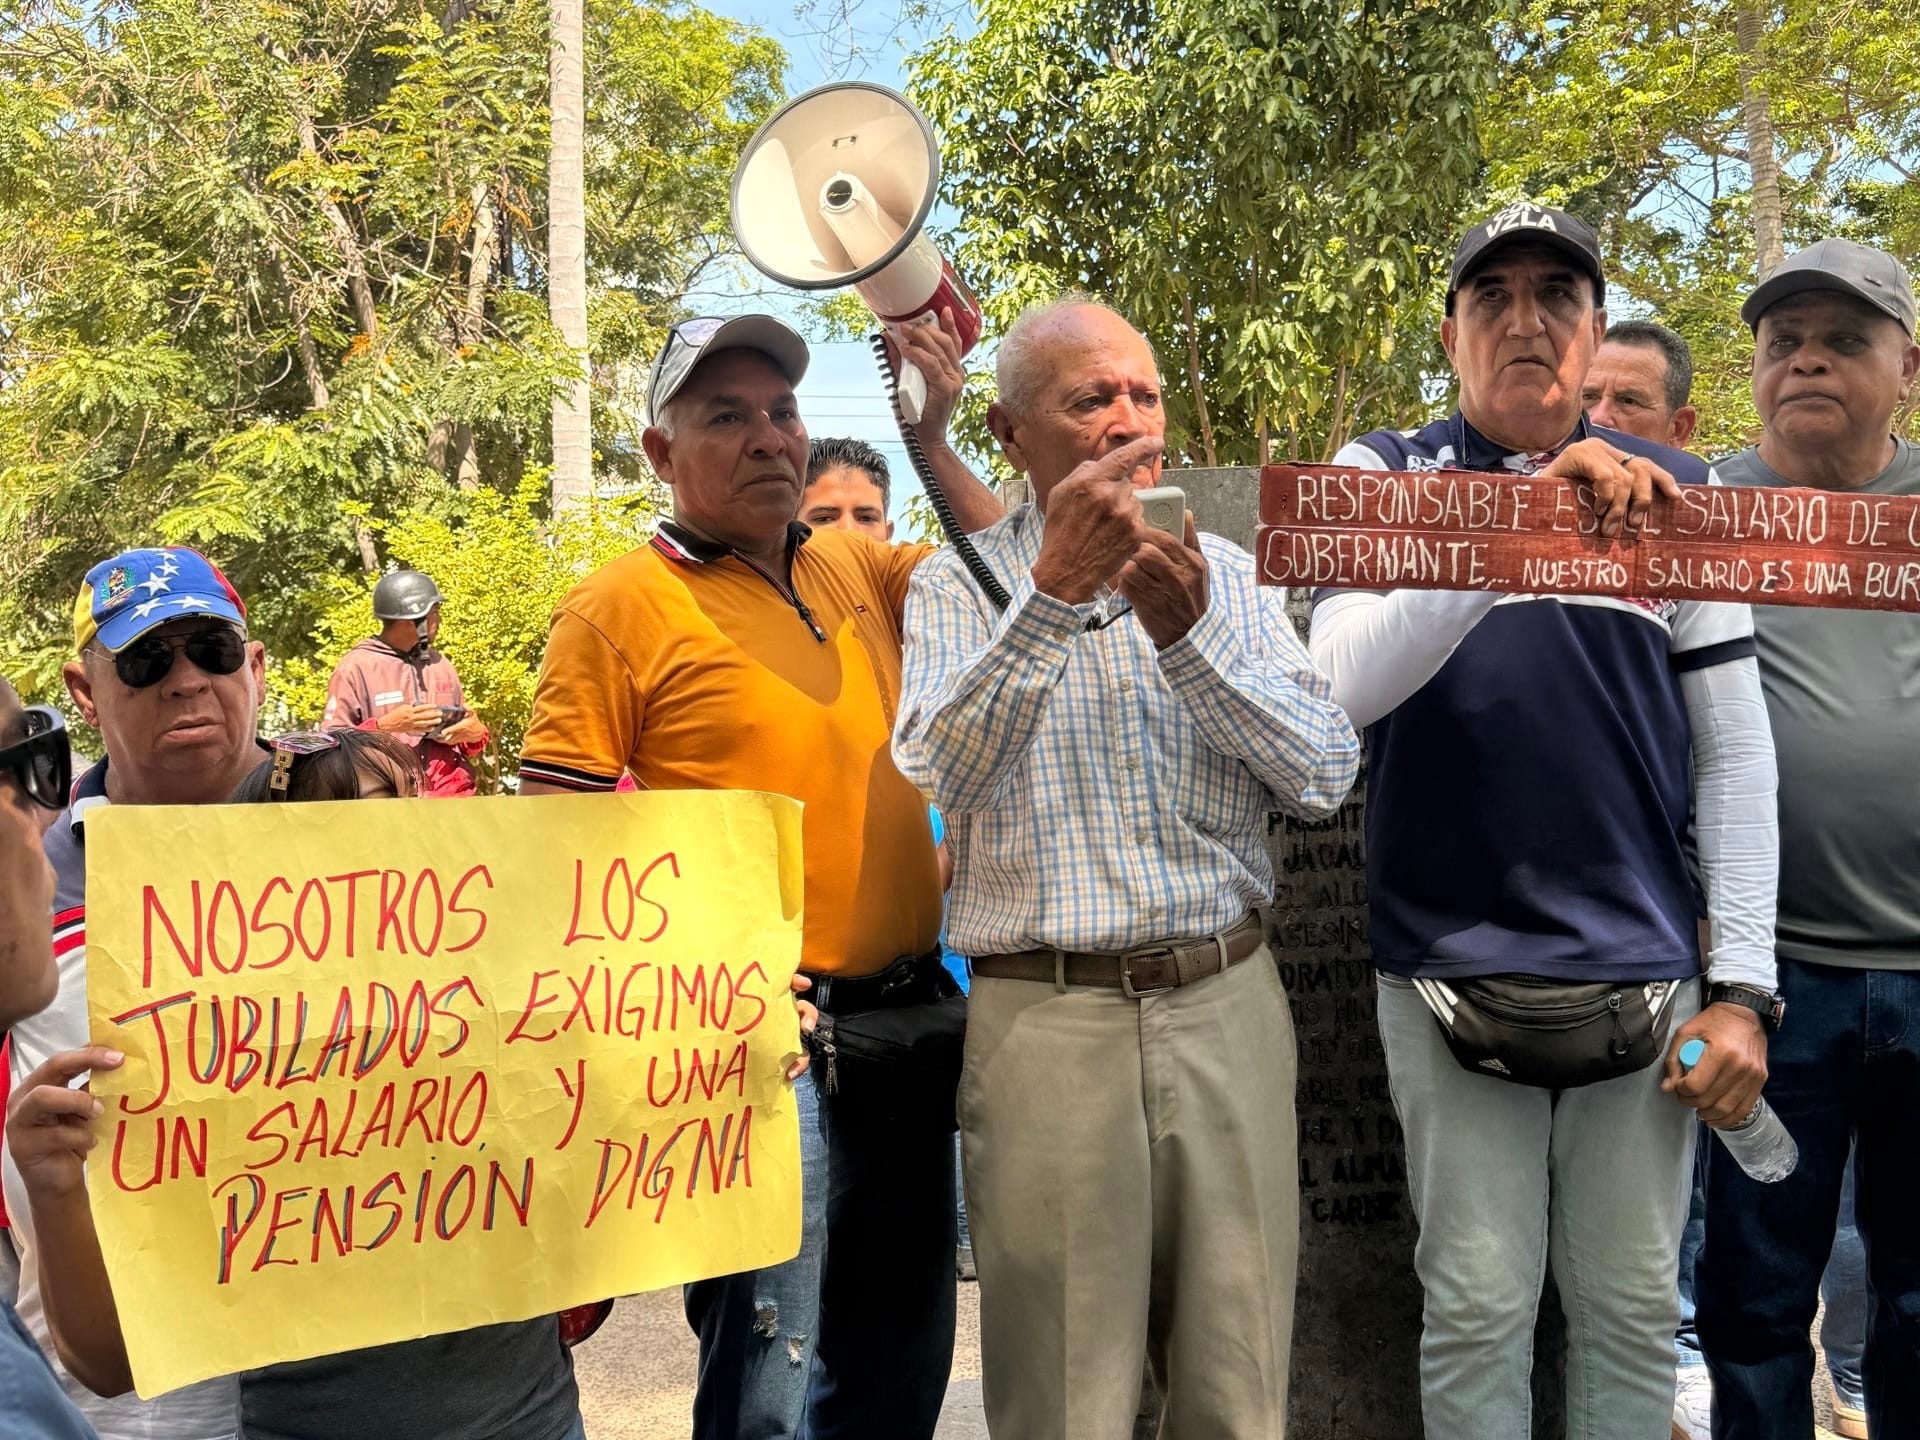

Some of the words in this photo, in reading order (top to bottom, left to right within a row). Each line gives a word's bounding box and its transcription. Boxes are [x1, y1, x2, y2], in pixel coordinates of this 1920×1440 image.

[1485, 210, 1558, 238] VZLA
[1296, 474, 1532, 532] RESPONSABLE
[1552, 484, 1599, 534] ES
[1676, 487, 1827, 545] SALARIO
[1846, 500, 1890, 546] DE
[1522, 558, 1628, 589] NUESTRO
[1646, 557, 1751, 591] SALARIO
[1760, 560, 1794, 593] ES
[1804, 561, 1853, 595] UNA
[1864, 562, 1920, 602] BUR
[142, 863, 495, 988] NOSOTROS
[563, 851, 681, 947] LOS
[110, 973, 485, 1115] JUBILADOS
[504, 956, 770, 1045] EXIGIMOS
[111, 1116, 209, 1192] UN
[554, 1058, 586, 1151] Y
[647, 1040, 748, 1108] UNA
[584, 1105, 754, 1229] DIGNA
